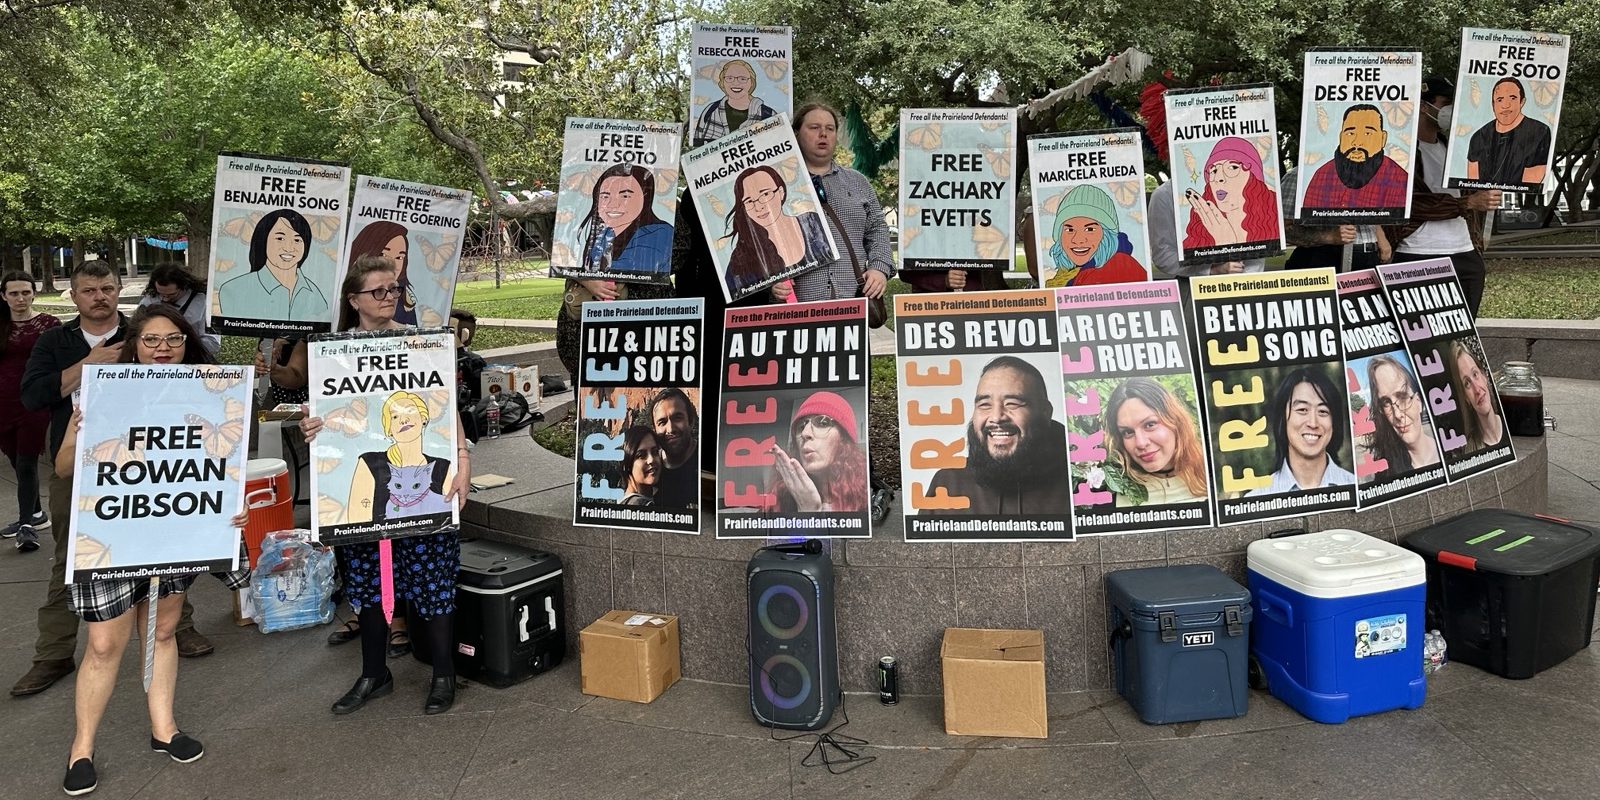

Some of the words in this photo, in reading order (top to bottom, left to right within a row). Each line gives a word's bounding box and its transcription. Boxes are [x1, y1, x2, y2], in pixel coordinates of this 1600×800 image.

[725, 36, 759, 47] FREE
[1472, 32, 1484, 40] Free
[1503, 35, 1531, 44] Prairieland
[1532, 37, 1563, 46] Defendants!
[698, 47, 740, 57] REBECCA
[742, 49, 785, 58] MORGAN
[1380, 57, 1414, 65] Defendants!
[1499, 45, 1535, 60] FREE
[1346, 68, 1380, 81] FREE
[1468, 59, 1508, 76] INES
[1512, 63, 1560, 80] SOTO
[1175, 99, 1186, 107] Free
[1205, 94, 1234, 104] Prairieland
[1236, 92, 1266, 101] Defendants!
[1315, 85, 1348, 101] DES
[1353, 85, 1409, 101] REVOL
[1205, 106, 1236, 121] FREE
[605, 123, 640, 131] Prairieland
[1174, 122, 1235, 141] AUTUMN
[1240, 119, 1269, 134] HILL
[600, 133, 643, 148] FREE
[690, 154, 701, 162] Free
[710, 144, 718, 153] the
[719, 132, 748, 149] Prairieland
[749, 118, 780, 137] Defendants!
[1060, 141, 1068, 149] the
[1070, 139, 1100, 148] Prairieland
[1102, 136, 1134, 146] Defendants!
[585, 149, 609, 162] LIZ
[613, 150, 657, 165] SOTO
[721, 140, 755, 163] FREE
[1068, 151, 1106, 167] FREE
[229, 161, 243, 170] Free
[245, 162, 253, 171] all
[254, 164, 264, 172] the
[266, 165, 302, 175] Prairieland
[303, 168, 341, 179] Defendants!
[694, 160, 745, 189] MEAGAN
[747, 140, 792, 167] MORRIS
[932, 154, 982, 172] FREE
[1039, 168, 1097, 183] MARICELA
[1100, 165, 1137, 178] RUEDA
[261, 176, 306, 194] FREE
[367, 180, 380, 189] Free
[390, 183, 399, 191] the
[400, 185, 431, 196] Prairieland
[432, 190, 464, 200] Defendants!
[909, 181, 1006, 199] ZACHARY
[1459, 181, 1528, 191] PrairielandDefendants.com
[224, 190, 294, 207] BENJAMIN
[298, 197, 339, 210] SONG
[397, 196, 431, 212] FREE
[359, 206, 407, 222] JANETTE
[410, 213, 460, 228] GOERING
[921, 208, 992, 227] EVETTS
[1195, 244, 1266, 257] PrairielandDefendants.com
[915, 261, 993, 269] PrairielandDefendants.com
[1401, 269, 1426, 279] Prairieland
[1425, 265, 1451, 276] Defendants!
[563, 270, 651, 280] PrairielandDefendants.com
[741, 260, 818, 294] PrairielandDefendants.com
[1199, 284, 1216, 293] Free
[1218, 283, 1232, 292] the
[1234, 279, 1278, 290] Prairieland
[1280, 275, 1329, 288] Defendants!
[904, 302, 922, 311] Free
[924, 301, 938, 310] the
[941, 299, 990, 310] Prairieland
[992, 297, 1047, 308] Defendants!
[1064, 292, 1114, 303] Prairieland
[1116, 288, 1171, 300] Defendants!
[1392, 282, 1463, 315] SAVANNA
[587, 309, 602, 317] Free
[603, 309, 614, 317] the
[616, 307, 654, 317] Prairieland
[656, 305, 698, 315] Defendants!
[731, 314, 748, 323] Free
[750, 313, 762, 321] the
[764, 309, 808, 320] Prairieland
[810, 305, 860, 317] Defendants!
[1203, 297, 1333, 333] BENJAMIN
[1341, 294, 1390, 325] GAN
[224, 319, 313, 331] PrairielandDefendants.com
[1059, 310, 1179, 342] ARICELA
[1426, 308, 1472, 336] BATTEN
[588, 328, 619, 352] LIZ
[624, 331, 638, 352] &
[645, 326, 695, 351] INES
[729, 325, 859, 358] AUTUMN
[905, 321, 956, 349] DES
[964, 318, 1052, 347] REVOL
[1343, 322, 1400, 354] MORRIS
[321, 346, 337, 355] Free
[349, 345, 360, 353] the
[1264, 329, 1336, 361] SONG
[358, 354, 408, 372] FREE
[1097, 341, 1184, 372] RUEDA
[97, 369, 115, 378] Free
[118, 369, 129, 378] all
[131, 369, 144, 378] the
[147, 369, 193, 379] Prairieland
[195, 369, 243, 379] Defendants!
[634, 356, 695, 382] SOTO
[786, 355, 860, 384] HILL
[322, 371, 444, 396] SAVANNA
[1402, 315, 1467, 452] FREE
[1207, 334, 1273, 493] FREE
[581, 356, 628, 500] FREE
[724, 359, 779, 508] FREE
[905, 359, 970, 509] FREE
[128, 426, 202, 450] FREE
[1448, 446, 1511, 475] PrairielandDefendants.com
[96, 458, 226, 486] ROWAN
[94, 491, 223, 520] GIBSON
[1224, 490, 1350, 516] PrairielandDefendants.com
[581, 507, 693, 524] PrairielandDefendants.com
[724, 517, 862, 529] PrairielandDefendants.com
[1075, 507, 1203, 527] irielandDefendants.com
[334, 518, 433, 536] PrairielandDefendants.com
[913, 519, 1064, 532] PrairielandDefendants.com
[92, 565, 210, 580] PrairielandDefendants.com
[1185, 634, 1211, 644] YETI
